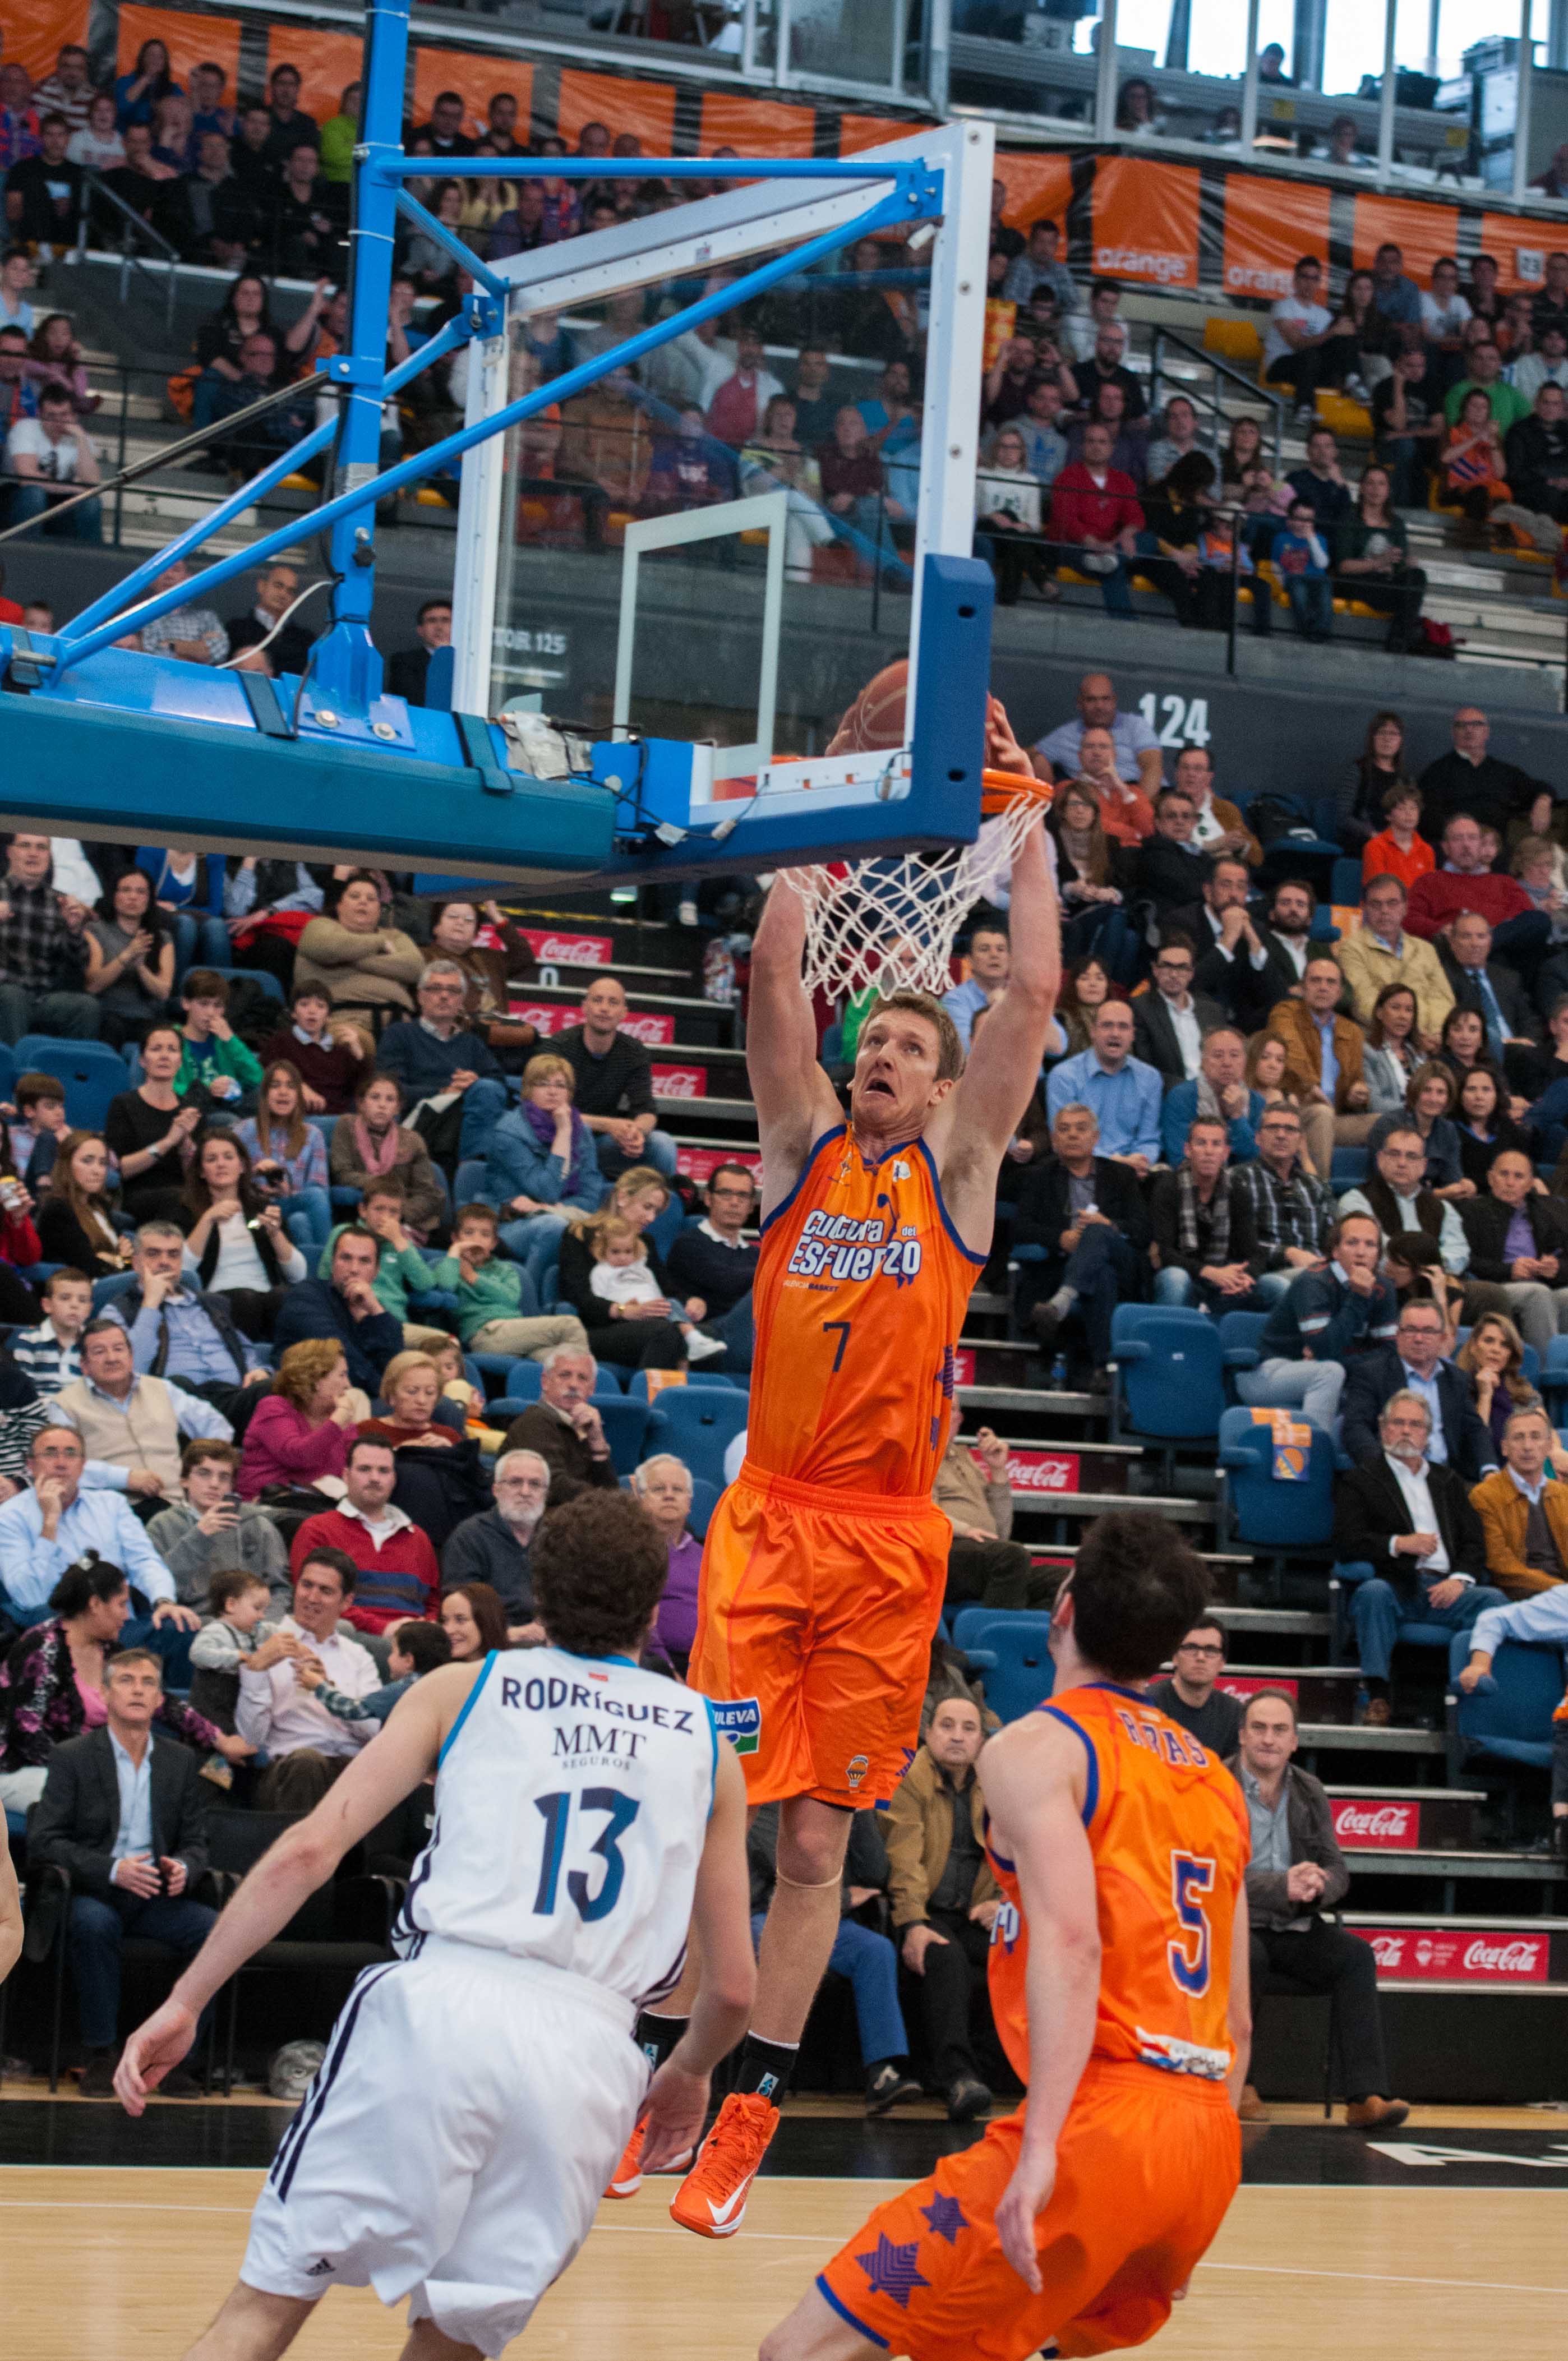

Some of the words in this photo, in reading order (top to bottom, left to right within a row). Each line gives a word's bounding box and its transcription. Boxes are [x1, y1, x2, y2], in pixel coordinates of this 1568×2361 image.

[1097, 248, 1186, 281] orange
[537, 633, 566, 654] 125
[1139, 691, 1212, 748] 124
[901, 1226, 917, 1237] del
[823, 1322, 851, 1373] 7
[714, 1708, 757, 1726] ULEVA
[551, 1723, 647, 1759] MMT
[561, 1756, 631, 1771] SEGUROS
[532, 1787, 641, 1924] 13
[1167, 1848, 1216, 1998] 5
